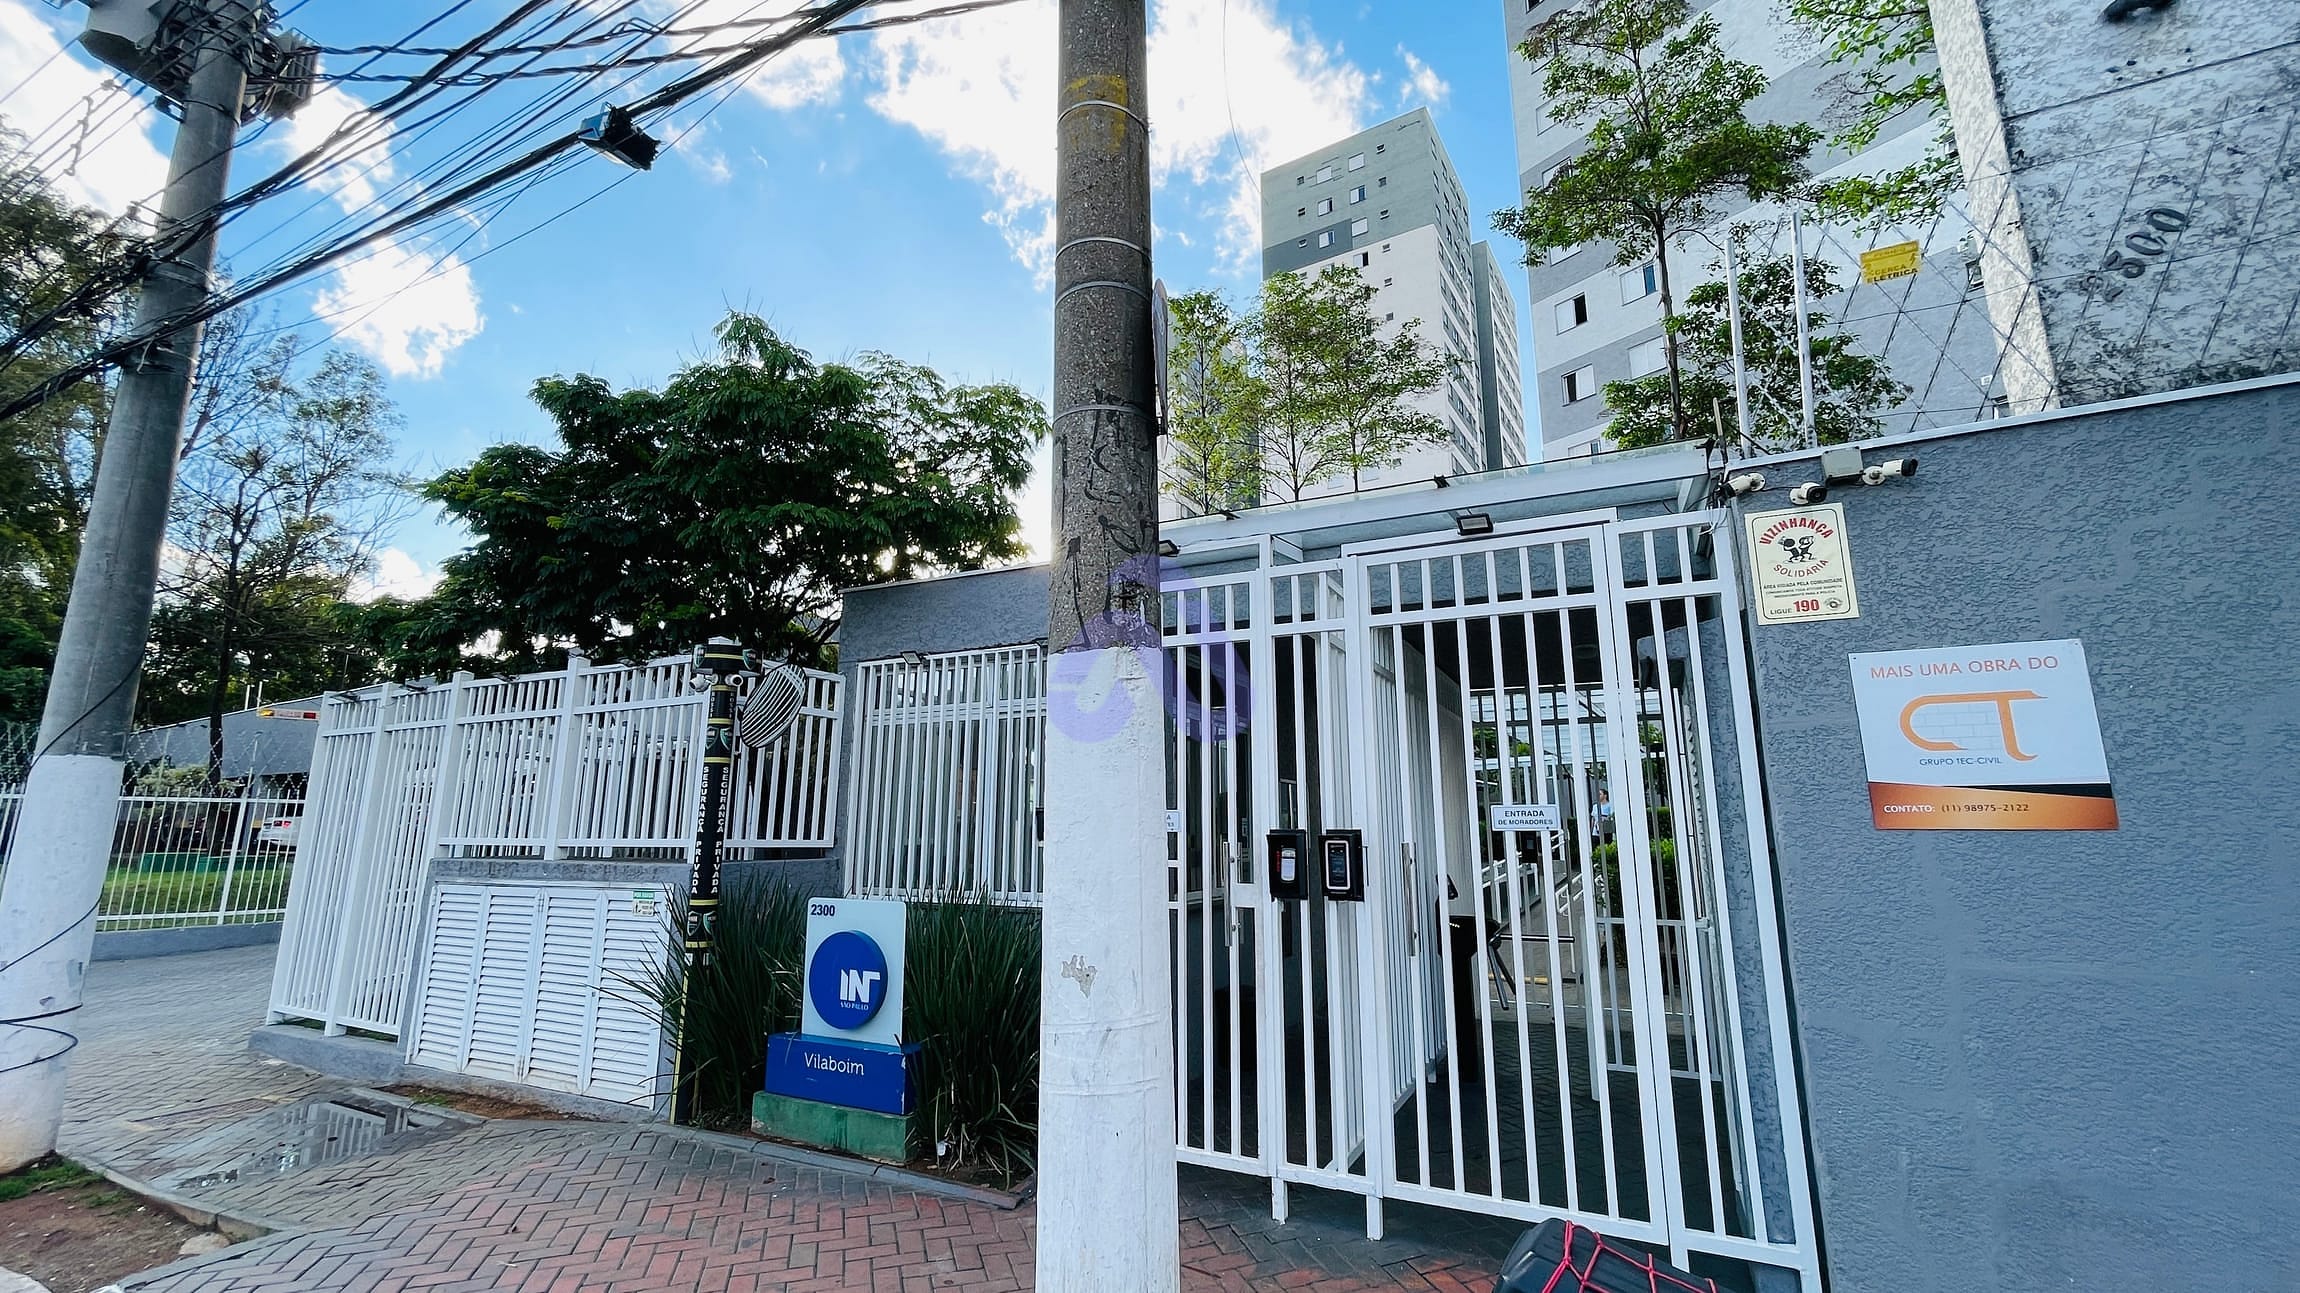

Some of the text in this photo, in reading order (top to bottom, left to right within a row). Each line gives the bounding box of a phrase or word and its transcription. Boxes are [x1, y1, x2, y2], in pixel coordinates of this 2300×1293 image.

[1760, 518, 1834, 545] VIZINHANÇA
[1793, 599, 1820, 612] 190
[1870, 656, 2058, 679] MAIS UMA OBRA DO
[1919, 757, 2003, 766] GRUPO TEC-CIVIL
[1883, 804, 2030, 813] CONTATO: (11) 98975-2122
[691, 766, 710, 894] SEGURANÇA PRIVADA
[710, 766, 729, 894] SEGURANÇA PRIVADA
[810, 904, 835, 916] 2300
[804, 1052, 865, 1076] Vilaboim
